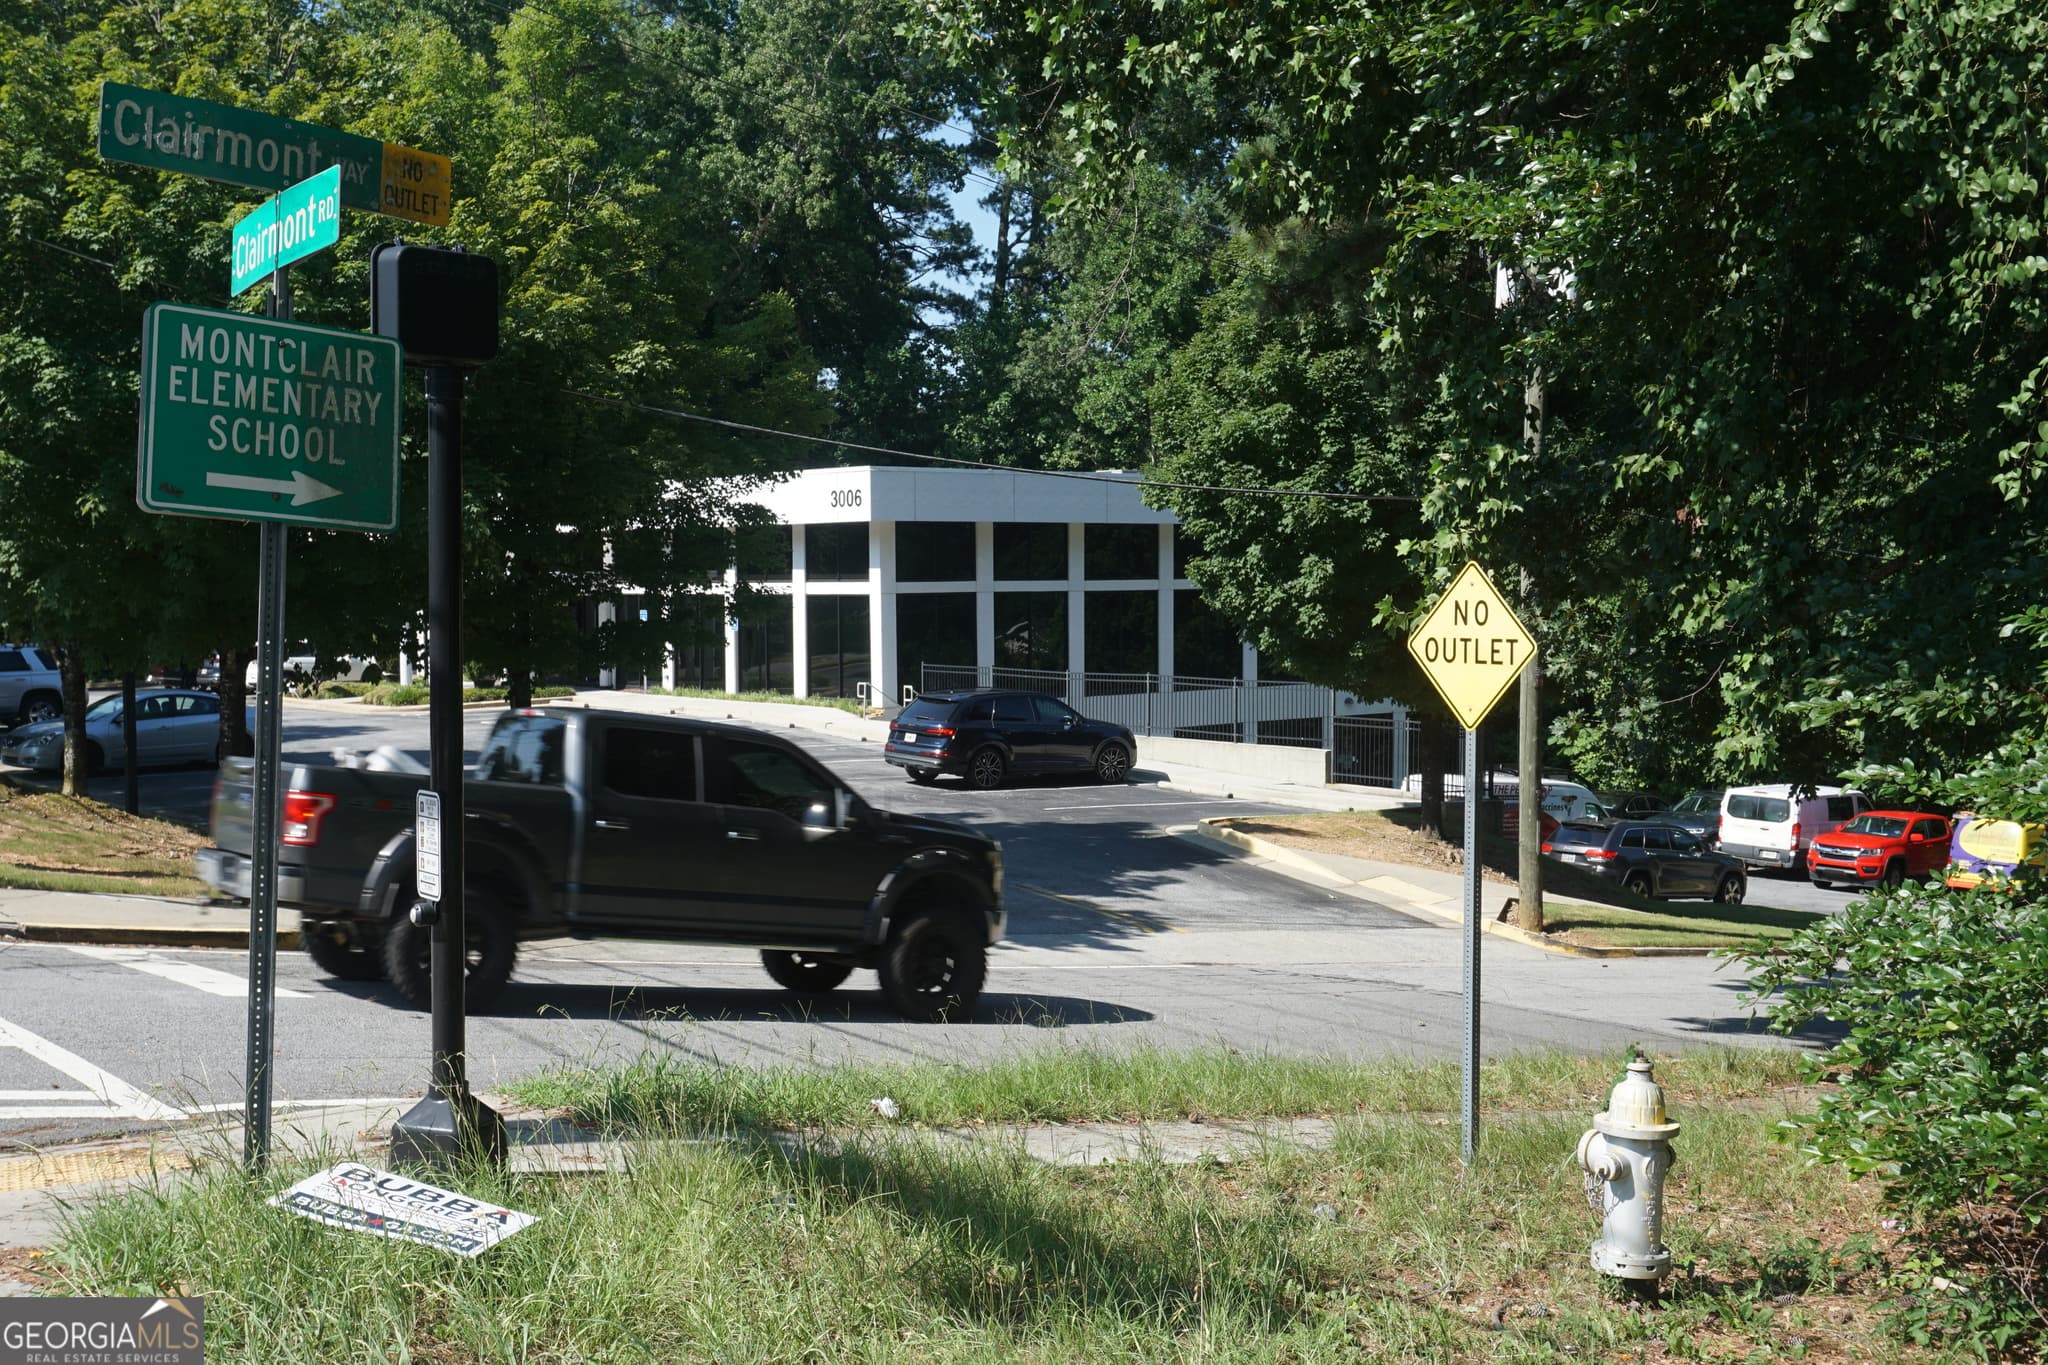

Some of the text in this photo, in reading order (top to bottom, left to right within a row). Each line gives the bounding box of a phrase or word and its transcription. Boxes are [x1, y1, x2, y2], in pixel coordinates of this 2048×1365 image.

[113, 99, 322, 178] Clairmont
[402, 158, 424, 183] NO
[384, 184, 439, 217] OUTLET
[236, 193, 317, 280] Clairmont
[179, 322, 376, 386] MONTCLAIR
[168, 364, 383, 427] ELEMENTARY
[207, 414, 346, 466] SCHOOL
[830, 489, 862, 508] 3006
[1454, 600, 1489, 626] NO
[1425, 637, 1519, 665] OUTLET
[1493, 784, 1510, 795] THE
[338, 1168, 512, 1226] BUBBA
